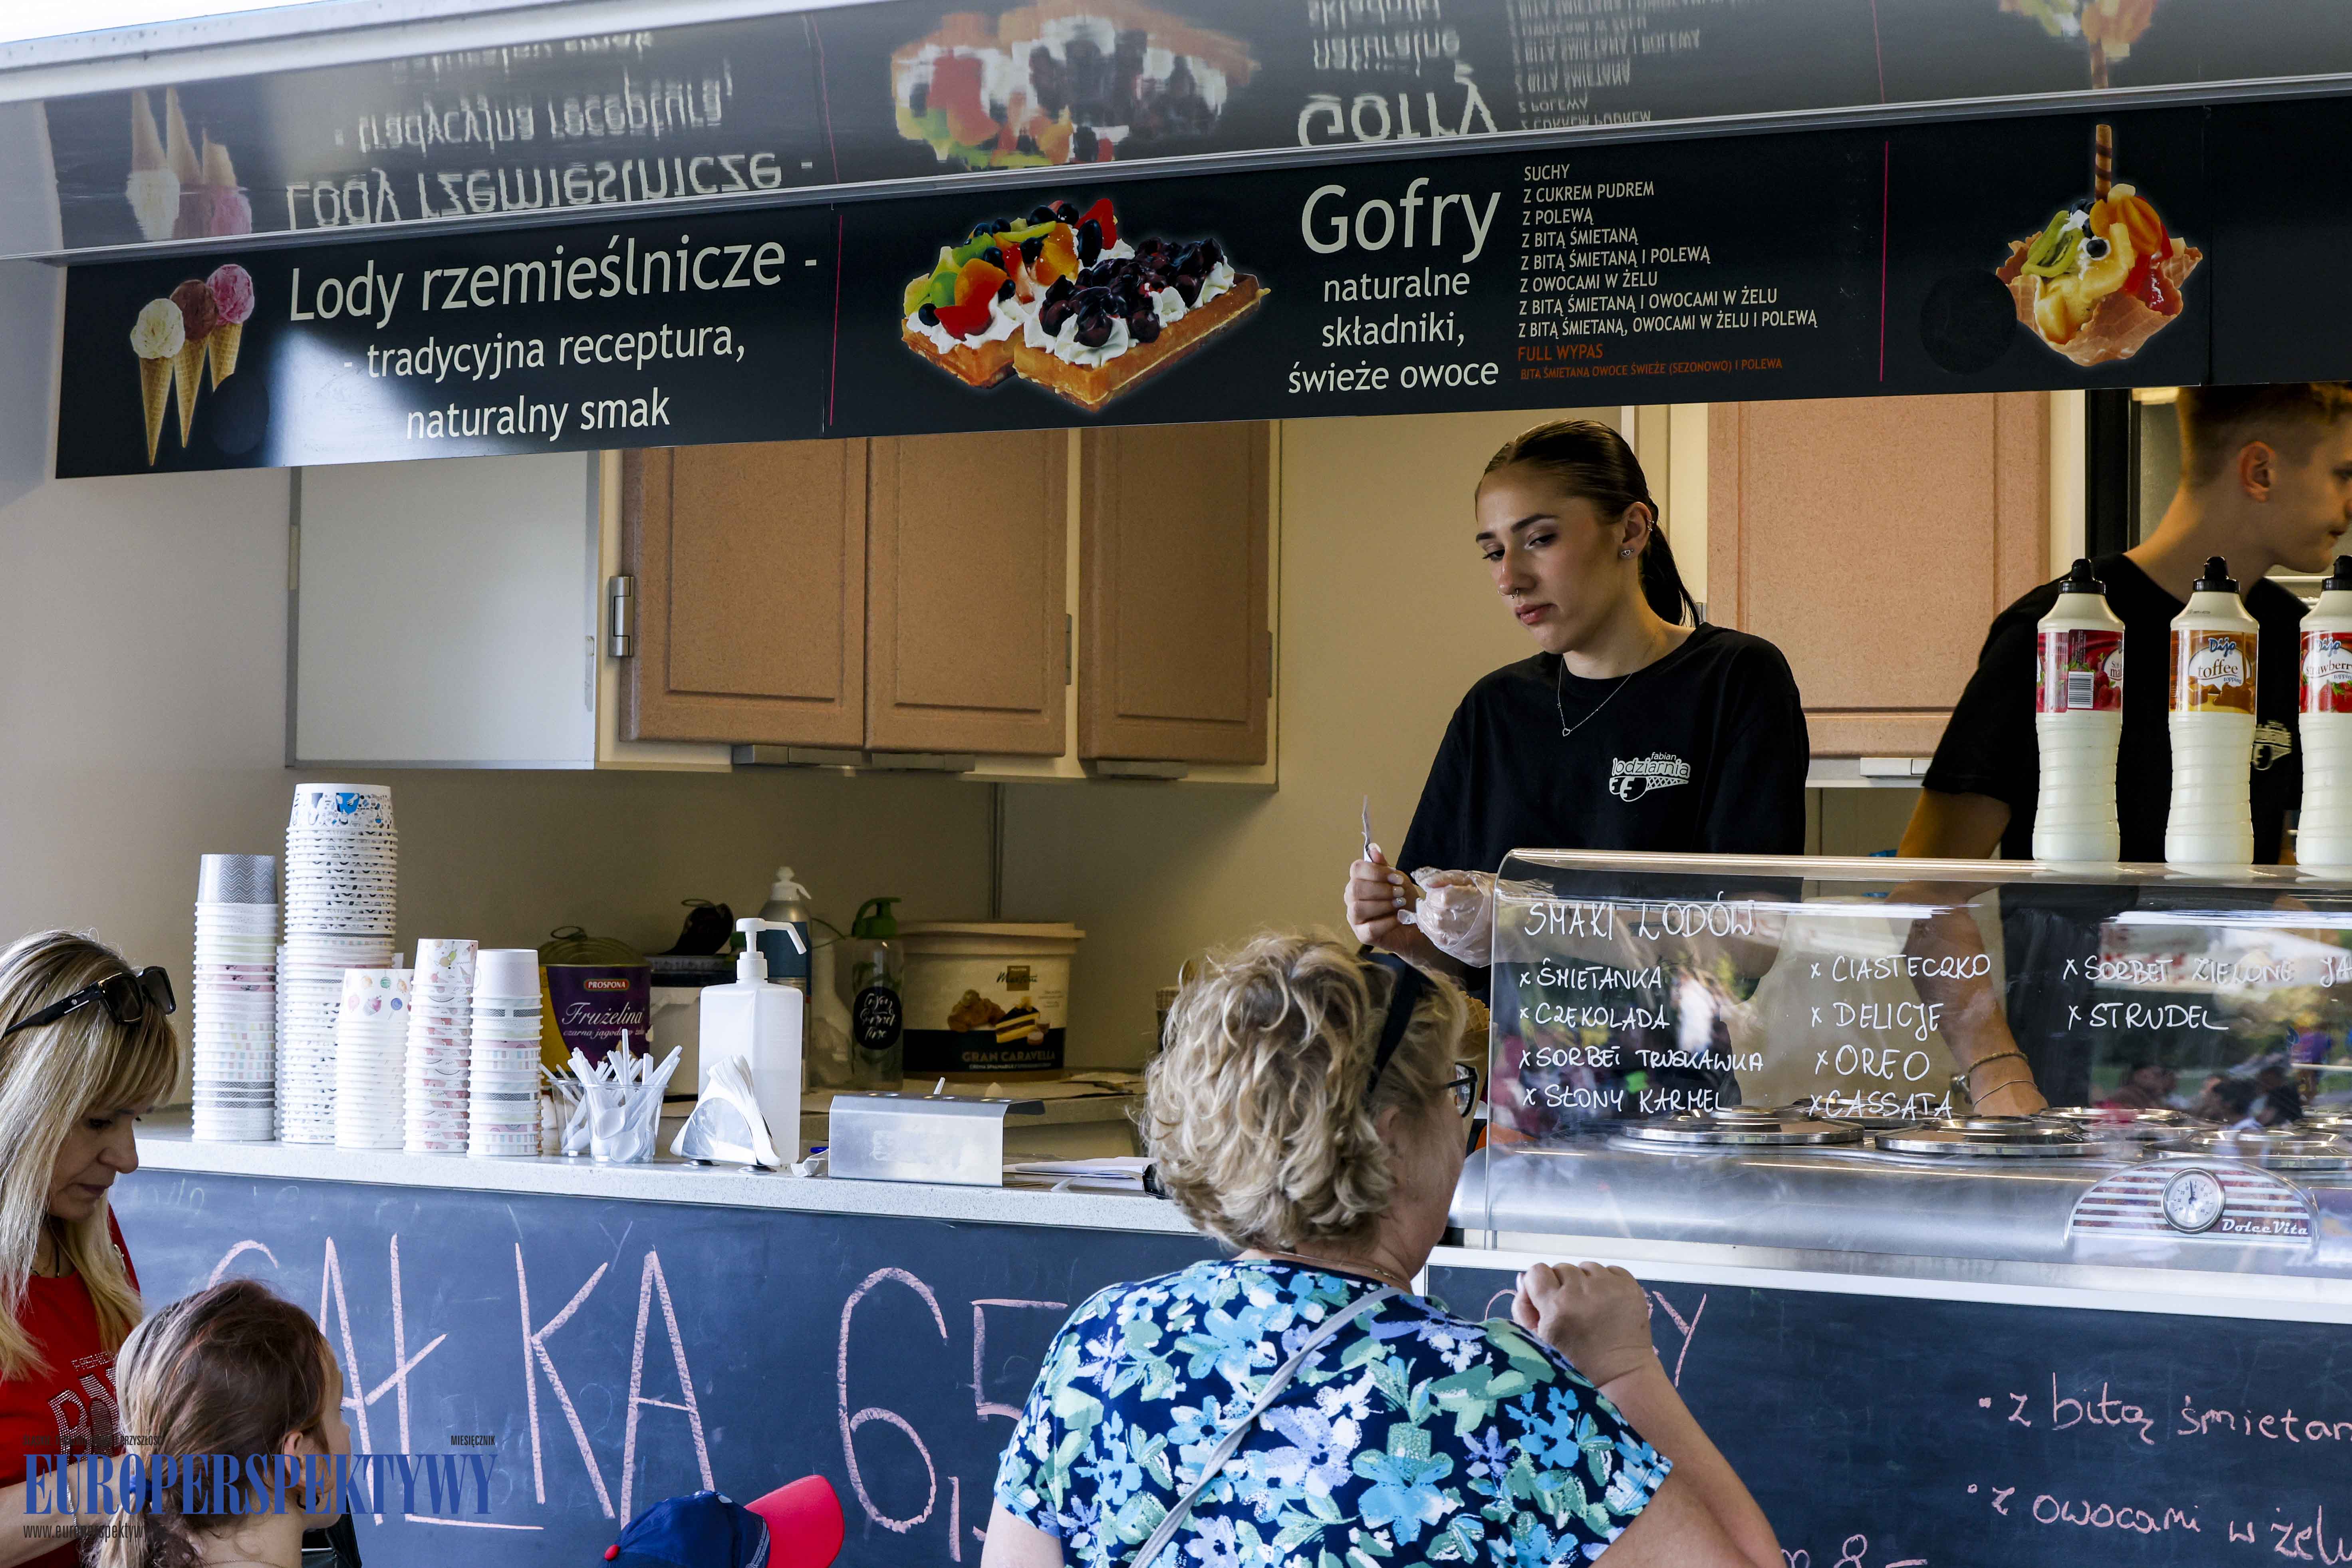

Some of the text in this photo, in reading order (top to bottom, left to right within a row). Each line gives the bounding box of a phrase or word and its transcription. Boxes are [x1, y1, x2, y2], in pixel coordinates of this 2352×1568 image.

[1524, 164, 1570, 181] SUCHY
[1523, 181, 1654, 203] Z CUKREM PUDREM
[1301, 178, 1501, 264] Gofry
[1522, 207, 1594, 226] Z POLEWĄ
[1522, 227, 1639, 249] Z BITĄ ŚMIETANĄ
[1521, 246, 1711, 272] Z BITĄ ŚMIETANĄ I POLEWĄ
[291, 260, 403, 327] Lody
[421, 234, 785, 312] rzemieślnicze
[1323, 268, 1469, 303] naturalne
[1520, 269, 1657, 293] Z OWOCAMI W ŻELU
[1519, 285, 1777, 316] Z BITĄ ŚMIETANĄ I OWOCAMI W ŻELU
[1322, 311, 1464, 350] składniki,
[1518, 309, 1818, 339] Z BITĄ ŚMIETANĄ, OWOCAMI W ŻELU I POLEWĄ
[367, 334, 544, 385] tradycyjna
[558, 324, 745, 370] receptura,
[1518, 343, 1604, 361] FULL WYPAS
[1288, 360, 1499, 395] świeże owoce
[1592, 365, 1628, 377] OWOCE
[1631, 361, 1666, 375] ŚWIEŻE
[1669, 361, 1732, 376] (SEZONOWO)
[1741, 358, 1783, 370] POLEWA
[407, 388, 670, 443] naturalny smak
[2198, 659, 2238, 678] toffee
[2334, 673, 2352, 681] toppin
[1612, 758, 1691, 779] lodziarnia
[1651, 752, 1677, 760] fabian
[1524, 891, 1756, 940] SMAKI LODÓW
[1536, 958, 1663, 990] ŚMIETANKA
[1832, 954, 1991, 982] CIASTECZKO
[2084, 955, 2173, 985] SORBET
[562, 1002, 643, 1025] Frużelina
[1535, 1003, 1670, 1031] CZEKOLADA
[1835, 1002, 1944, 1042] DELICJE
[2089, 1002, 2229, 1030] STRUDEL
[590, 1026, 622, 1040] jagod
[962, 1050, 1055, 1062] GRAN CARAVELLA
[1536, 1045, 1621, 1069] SORBET
[1635, 1048, 1764, 1072] TRUSKAWKA
[1835, 1044, 1930, 1082] OREO
[1546, 1084, 1624, 1112] SŁONY
[1639, 1088, 1733, 1113] KARMEL
[1826, 1089, 1953, 1121] CASSATA
[2221, 1219, 2308, 1235] Dolce Vita
[2008, 1392, 2032, 1427] z
[2052, 1372, 2155, 1445] bitą
[2033, 1494, 2201, 1534] owocami
